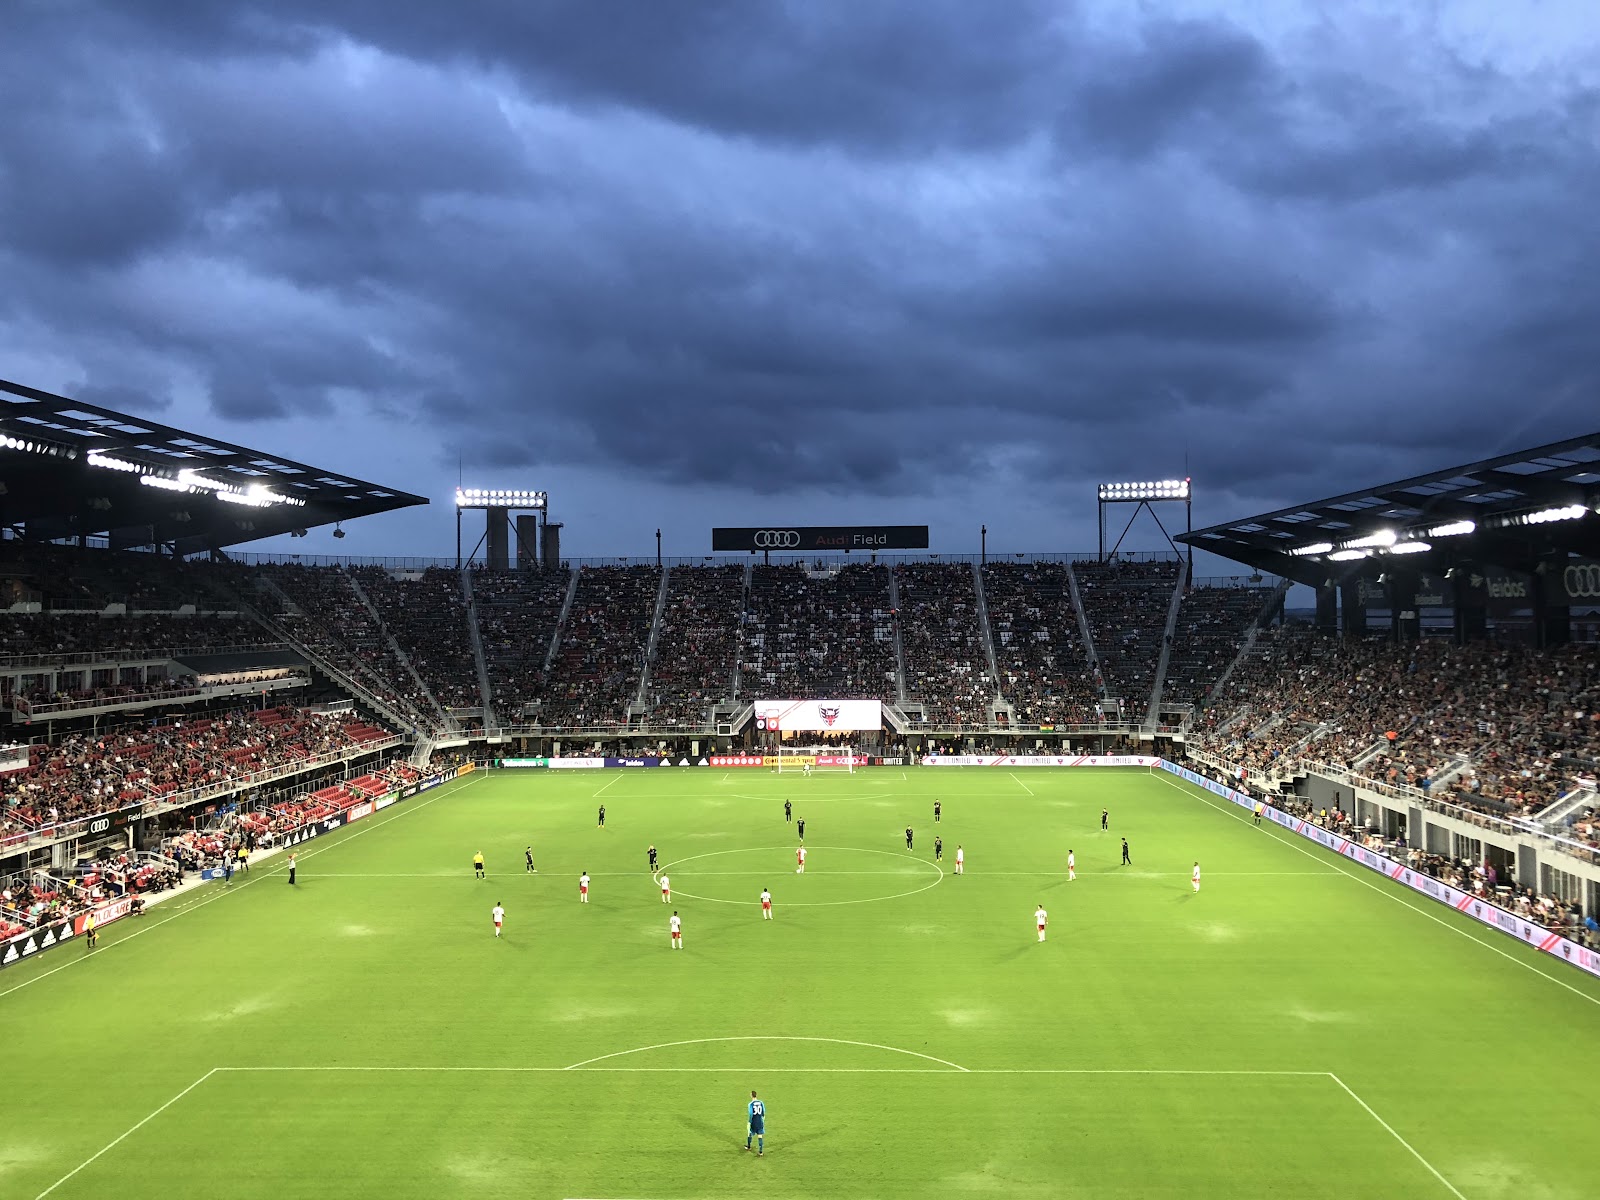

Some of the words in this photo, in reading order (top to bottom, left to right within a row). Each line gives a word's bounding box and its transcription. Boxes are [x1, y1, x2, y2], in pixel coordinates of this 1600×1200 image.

[816, 535, 849, 545] Audi
[853, 534, 887, 545] Field
[1487, 577, 1526, 597] leidos
[883, 757, 903, 765] UNITED
[128, 812, 141, 822] Field
[753, 1105, 762, 1115] 30
